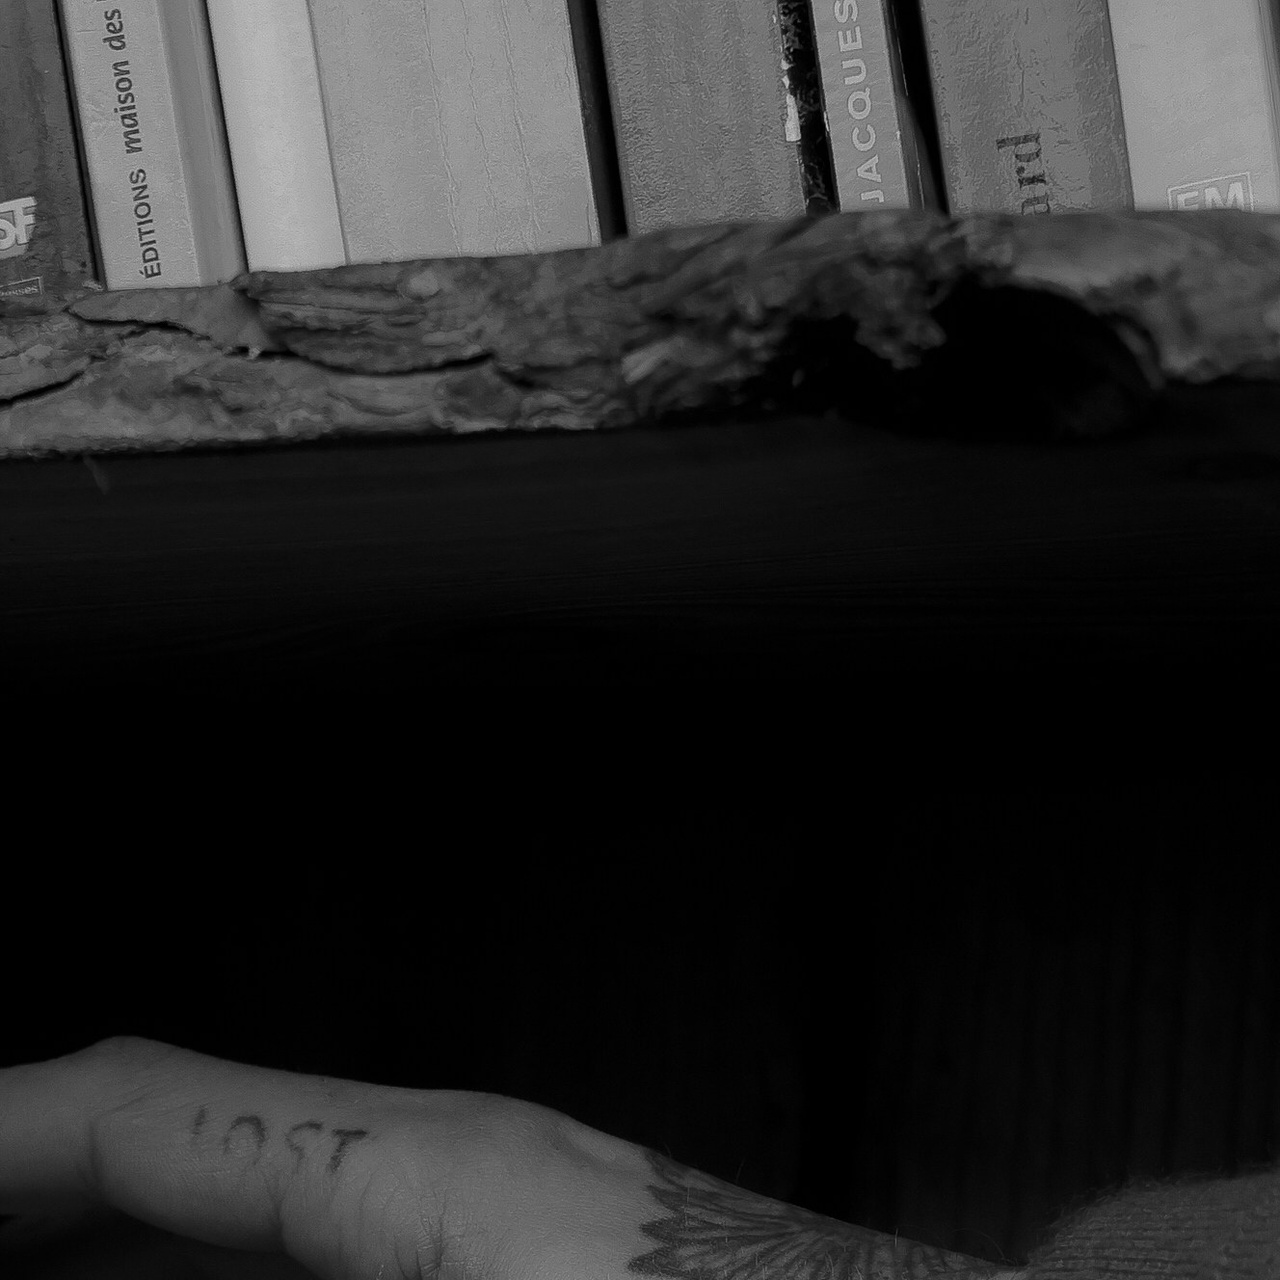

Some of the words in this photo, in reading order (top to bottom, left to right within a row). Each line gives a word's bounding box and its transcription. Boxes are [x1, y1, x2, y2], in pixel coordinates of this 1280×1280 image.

[101, 8, 125, 51] des
[113, 50, 145, 154] maison
[832, 0, 883, 205] JACQUES
[129, 167, 162, 280] ÉDITIONS
